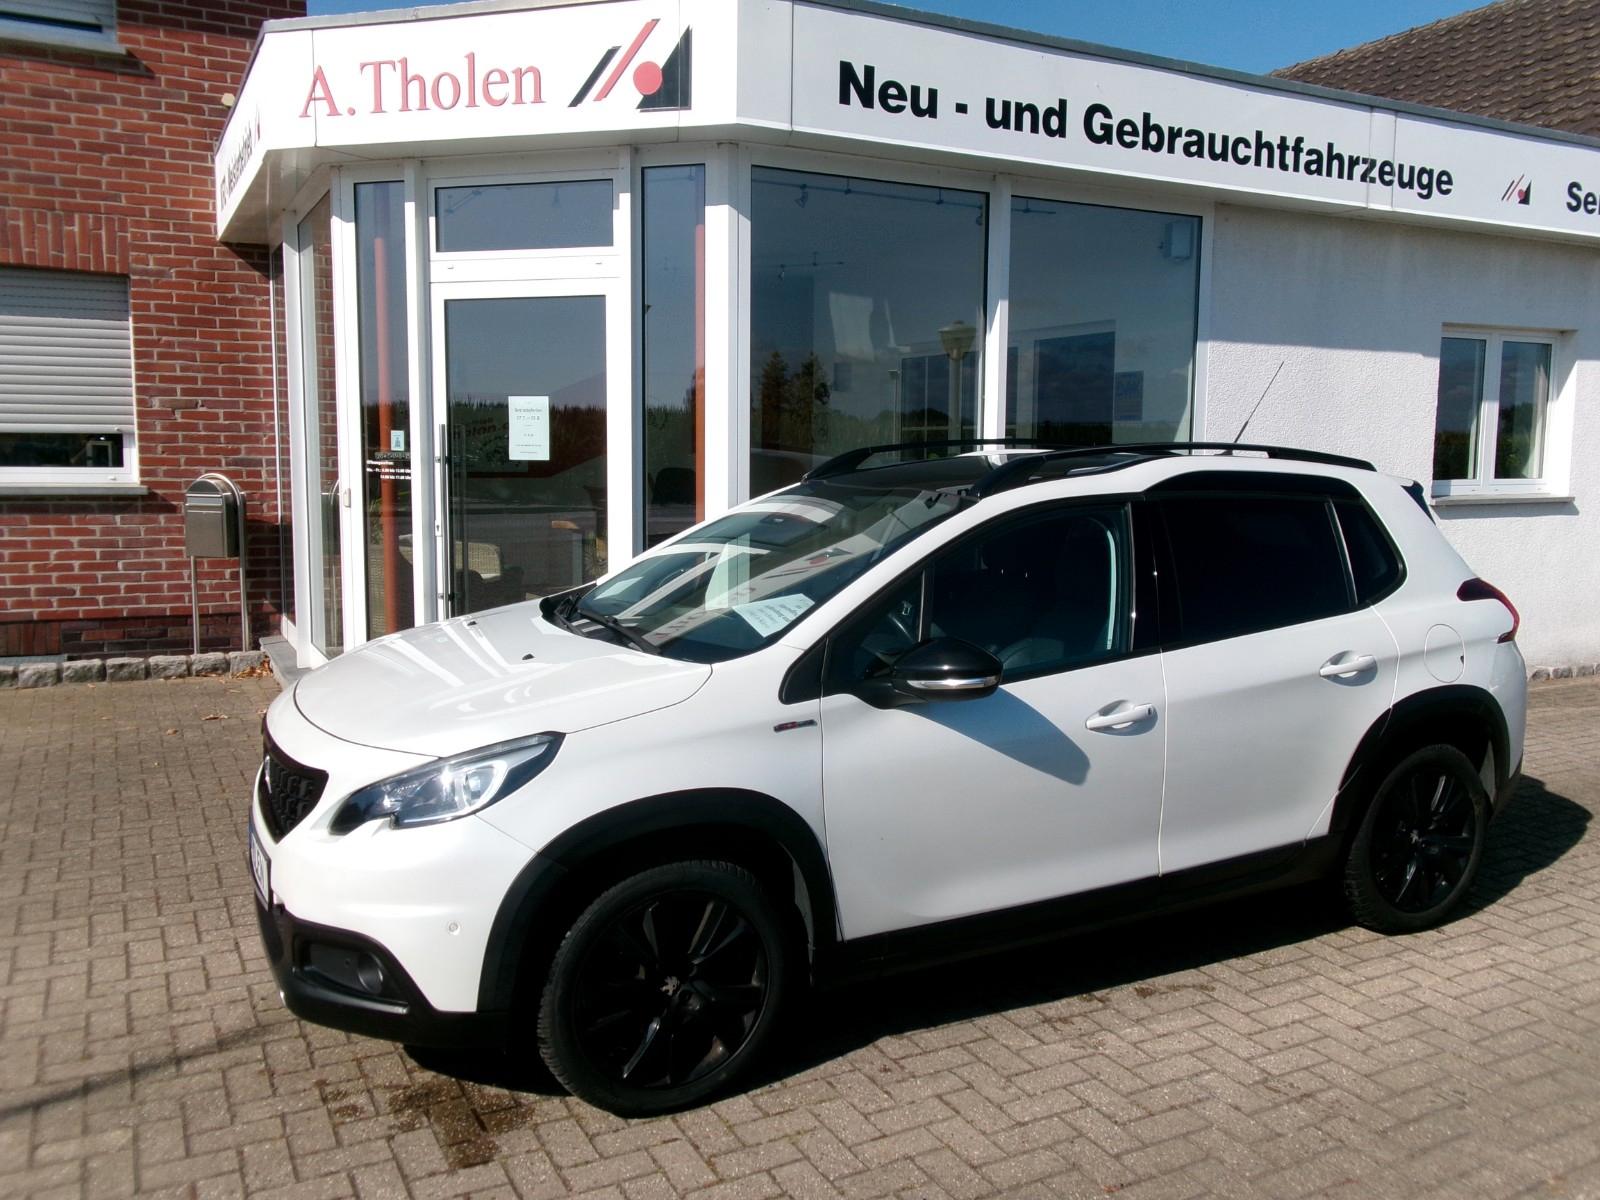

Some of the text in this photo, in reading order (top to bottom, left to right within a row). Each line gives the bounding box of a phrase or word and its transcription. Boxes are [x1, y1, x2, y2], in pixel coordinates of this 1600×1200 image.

[839, 60, 938, 119] Neu
[986, 97, 1068, 138] und
[1083, 103, 1454, 200] Gebrauchtfahrzeuge
[1566, 181, 1600, 215] Se
